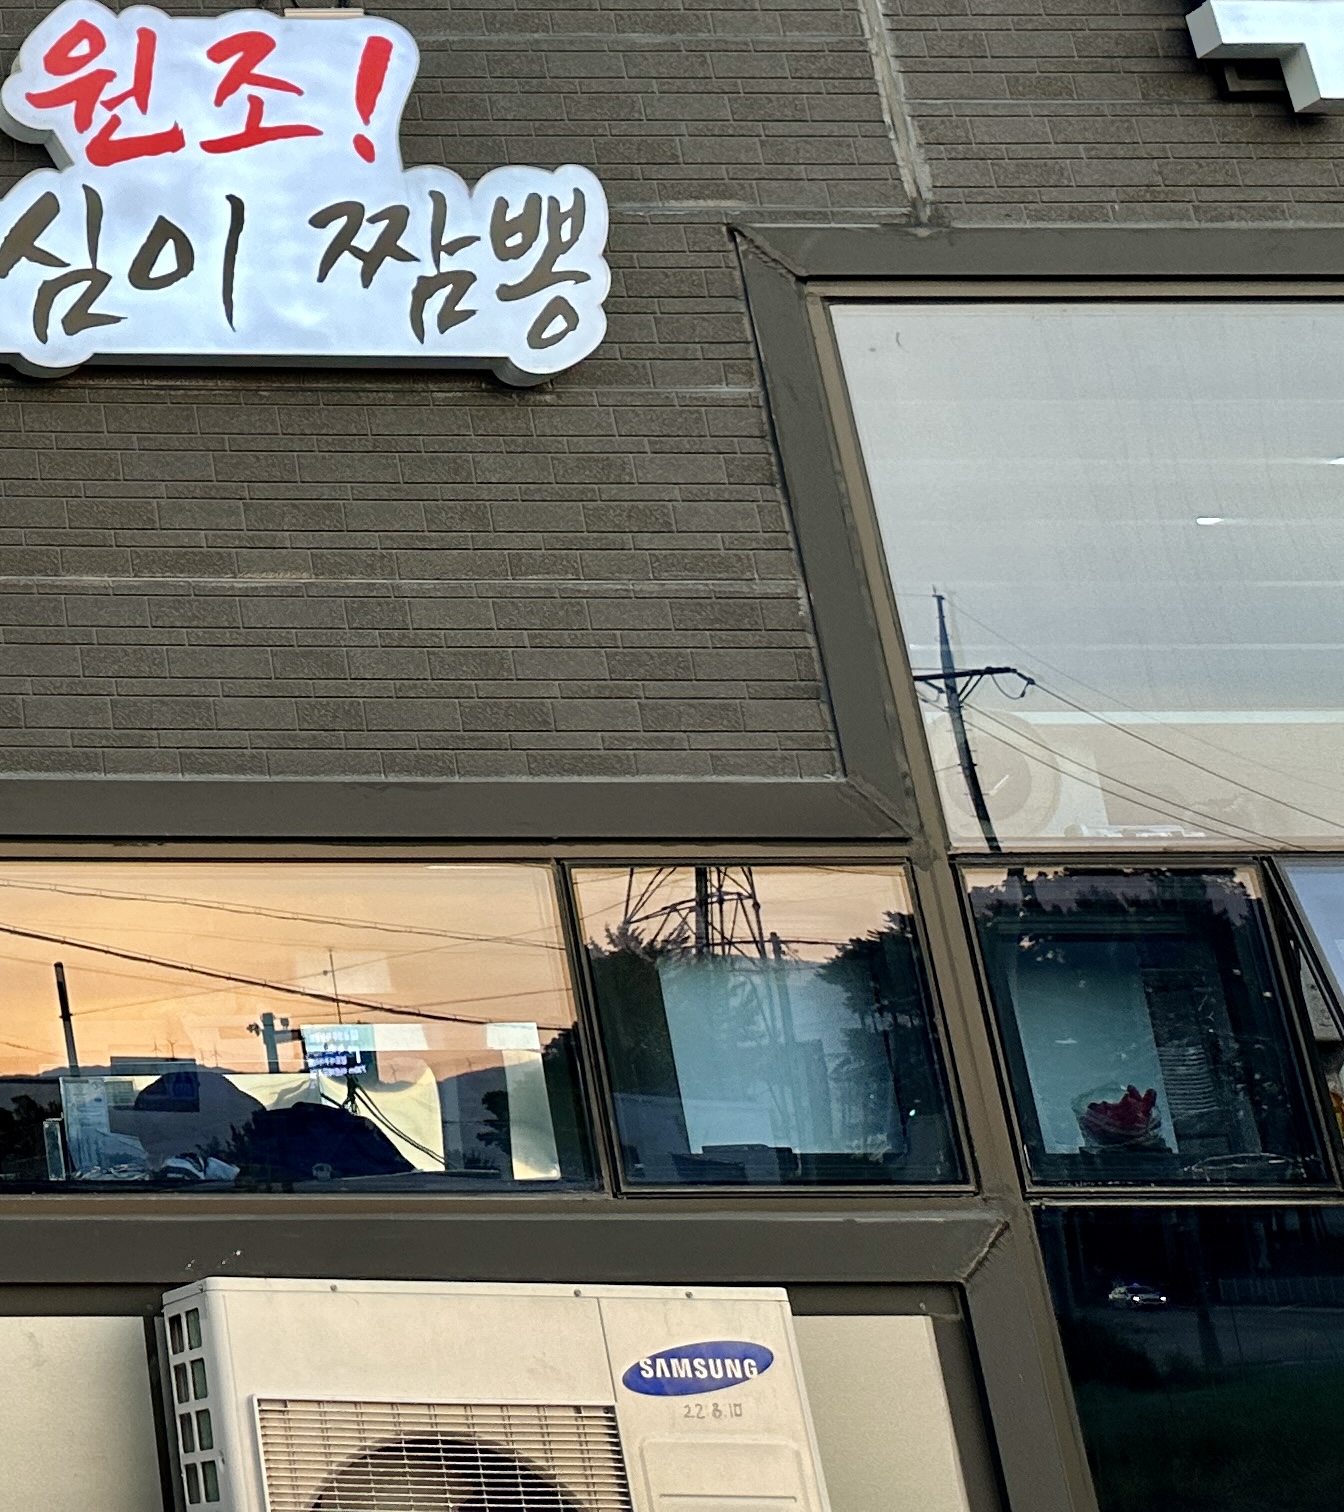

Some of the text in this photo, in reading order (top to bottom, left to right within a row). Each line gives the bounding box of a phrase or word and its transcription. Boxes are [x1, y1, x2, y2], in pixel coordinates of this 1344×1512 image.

[24, 18, 393, 168] 원조!
[308, 187, 590, 349] 짬뽕
[639, 1358, 757, 1379] SAMSUNG
